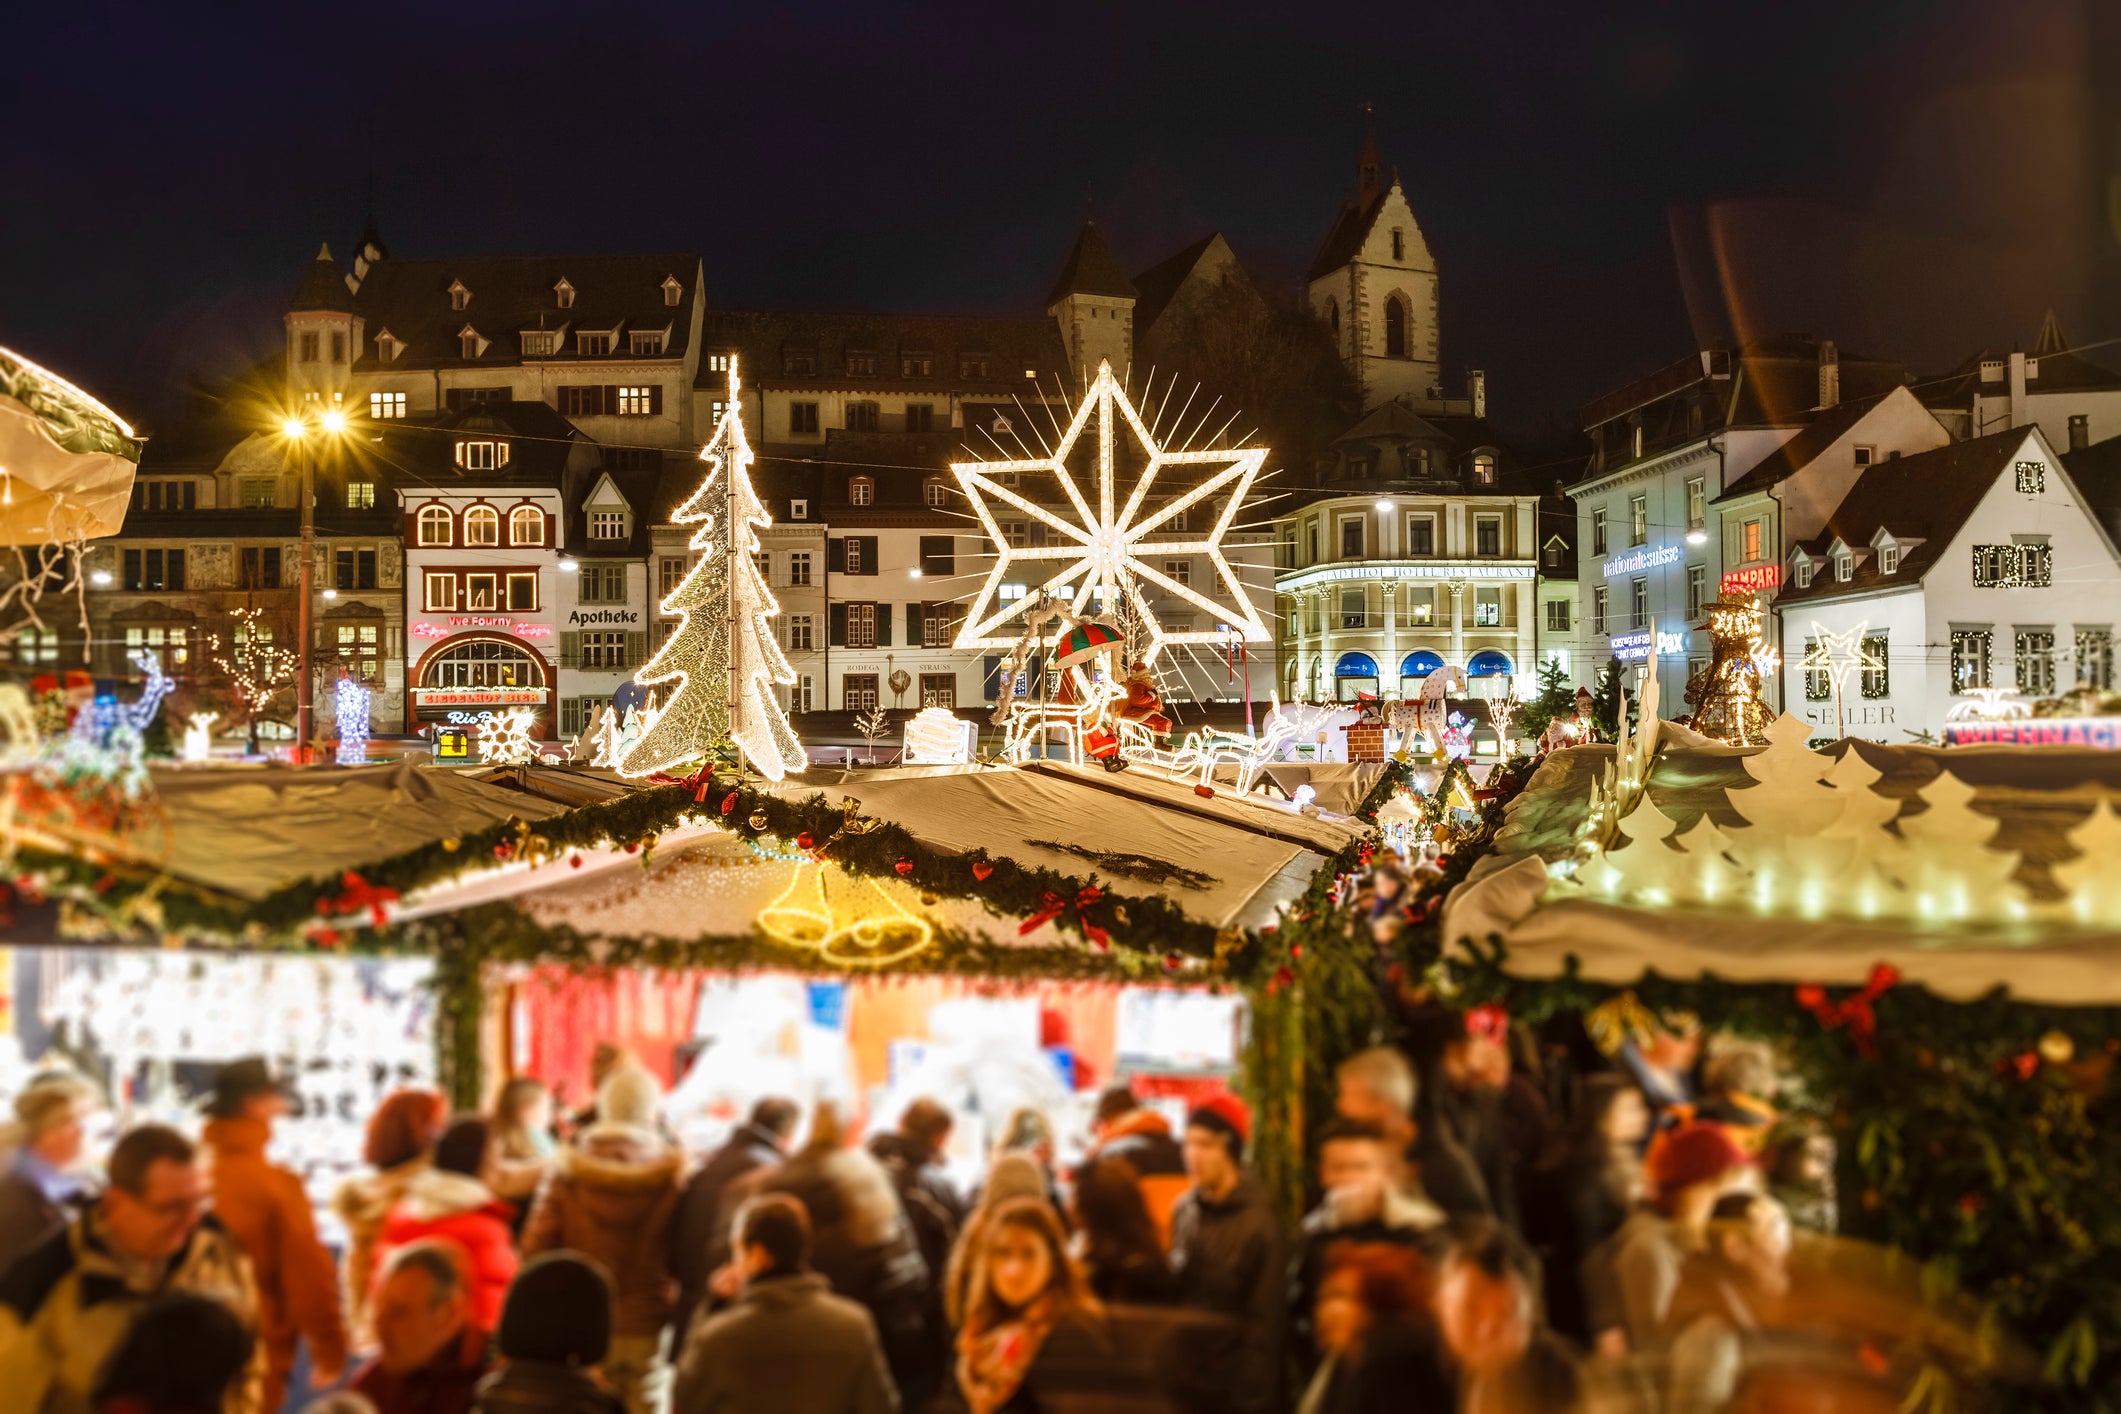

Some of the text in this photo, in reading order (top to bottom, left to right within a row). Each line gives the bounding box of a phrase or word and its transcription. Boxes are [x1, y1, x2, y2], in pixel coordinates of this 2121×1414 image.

[1603, 545, 1680, 577] nationalesuisse
[1443, 567, 1533, 577] RESTAURANT
[471, 617, 512, 627] Fourny
[568, 609, 638, 627] Apotheke
[1656, 632, 1683, 655] Pax
[424, 693, 539, 703] ZIEGELHOF BIER
[447, 711, 478, 724] Rio
[1806, 706, 1895, 725] SELER
